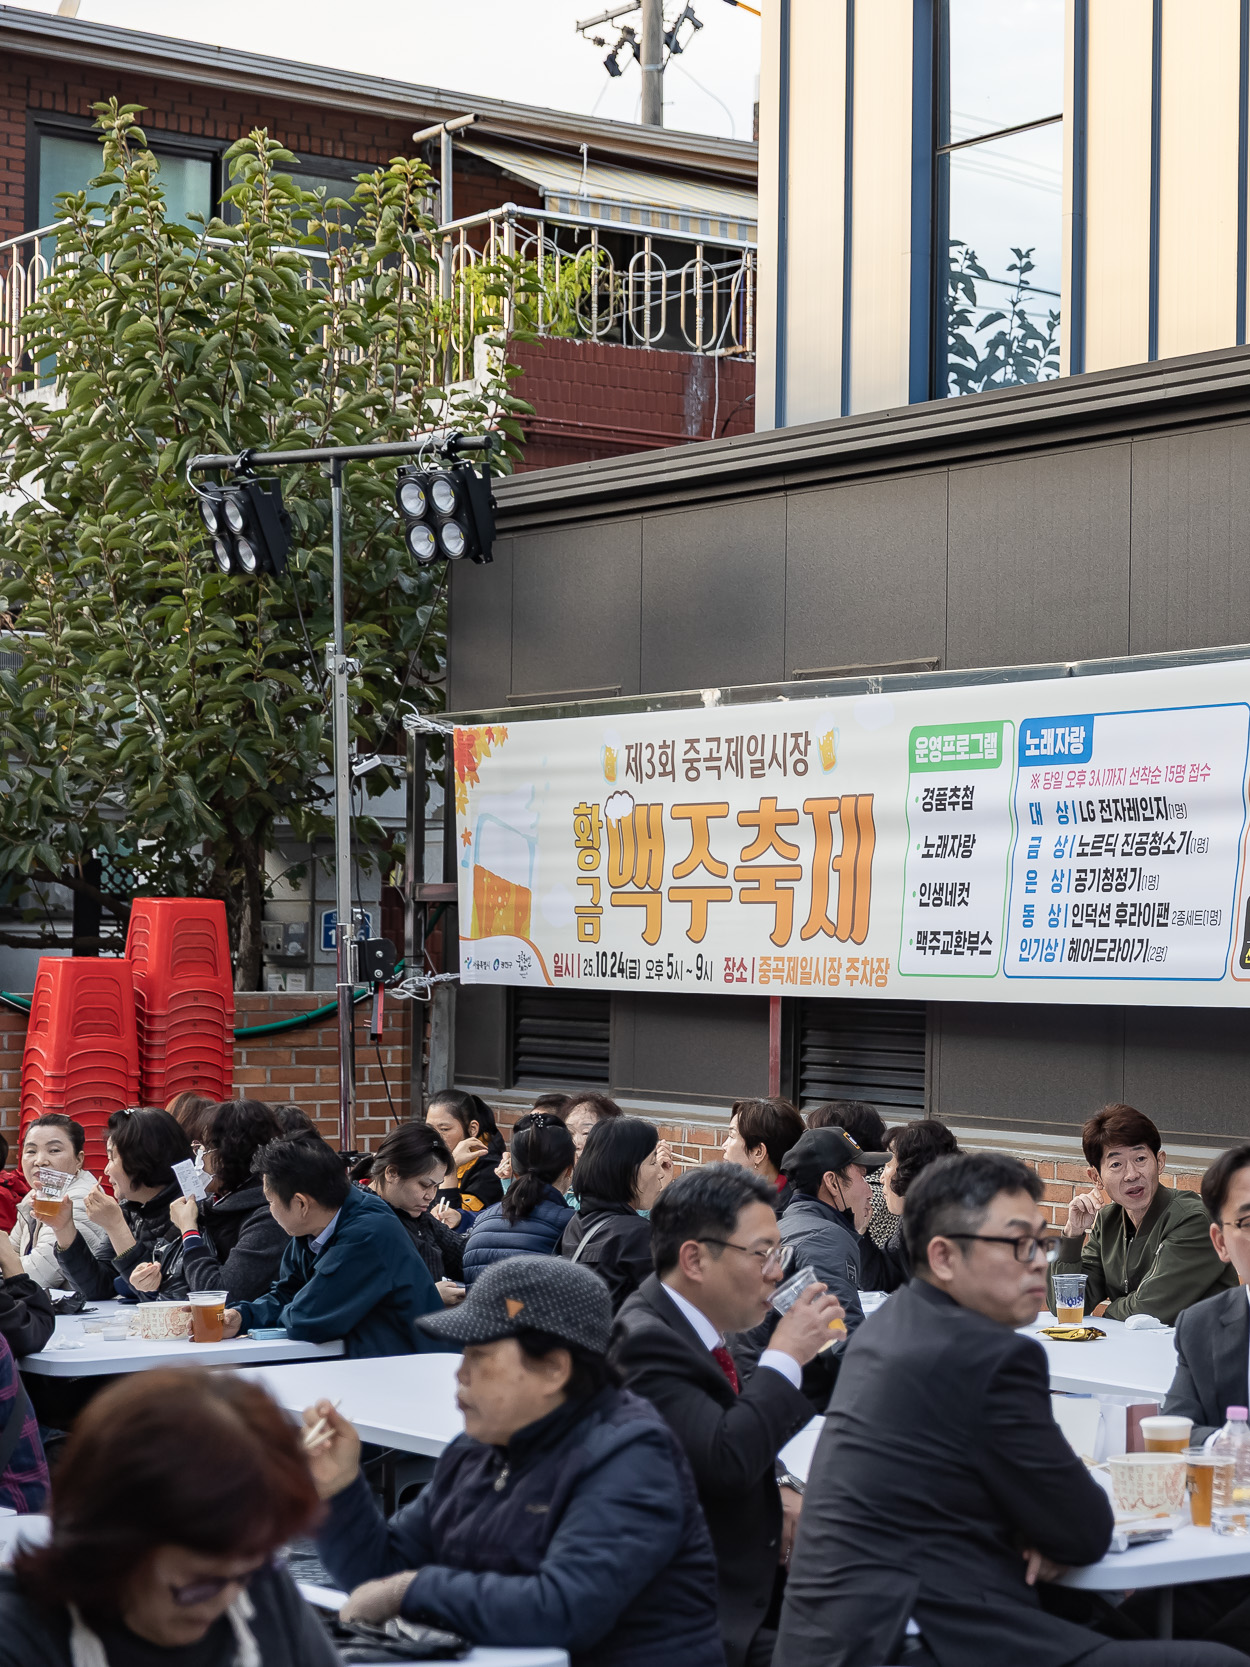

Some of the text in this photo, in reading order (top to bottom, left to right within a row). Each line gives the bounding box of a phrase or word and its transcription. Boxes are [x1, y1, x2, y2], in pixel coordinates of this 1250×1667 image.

[914, 731, 999, 764] 운영프로그램
[1024, 725, 1087, 756] 노래자랑
[624, 730, 812, 784] 제3회 중곡제일시장
[1042, 770, 1064, 790] 당일
[1065, 769, 1087, 789] 오후
[1088, 766, 1127, 788] 3시까지
[1129, 765, 1162, 786] 선착순
[1164, 764, 1187, 784] 15명
[1188, 762, 1212, 783] 접수
[921, 785, 975, 812] 경품추첨
[1078, 800, 1096, 823] LG
[921, 834, 977, 859] 노래자랑
[1076, 833, 1120, 858] 노르딕
[573, 802, 603, 943] 황금
[605, 793, 876, 947] 맥주축제
[918, 882, 971, 908] 인생네컷
[1071, 903, 1111, 928] 인덕션
[1114, 901, 1170, 928] 후라이팬
[915, 930, 993, 956] 맥주교환부스
[1018, 938, 1059, 963] 인기상
[553, 952, 574, 978] 일시
[583, 950, 640, 980] 25.10.24(금)
[645, 958, 664, 980] 오후
[666, 952, 683, 981] 5시
[695, 953, 713, 982] 9시
[723, 956, 748, 983] 장소
[758, 955, 842, 986] 중곡제일시장
[845, 956, 890, 987] 주차장
